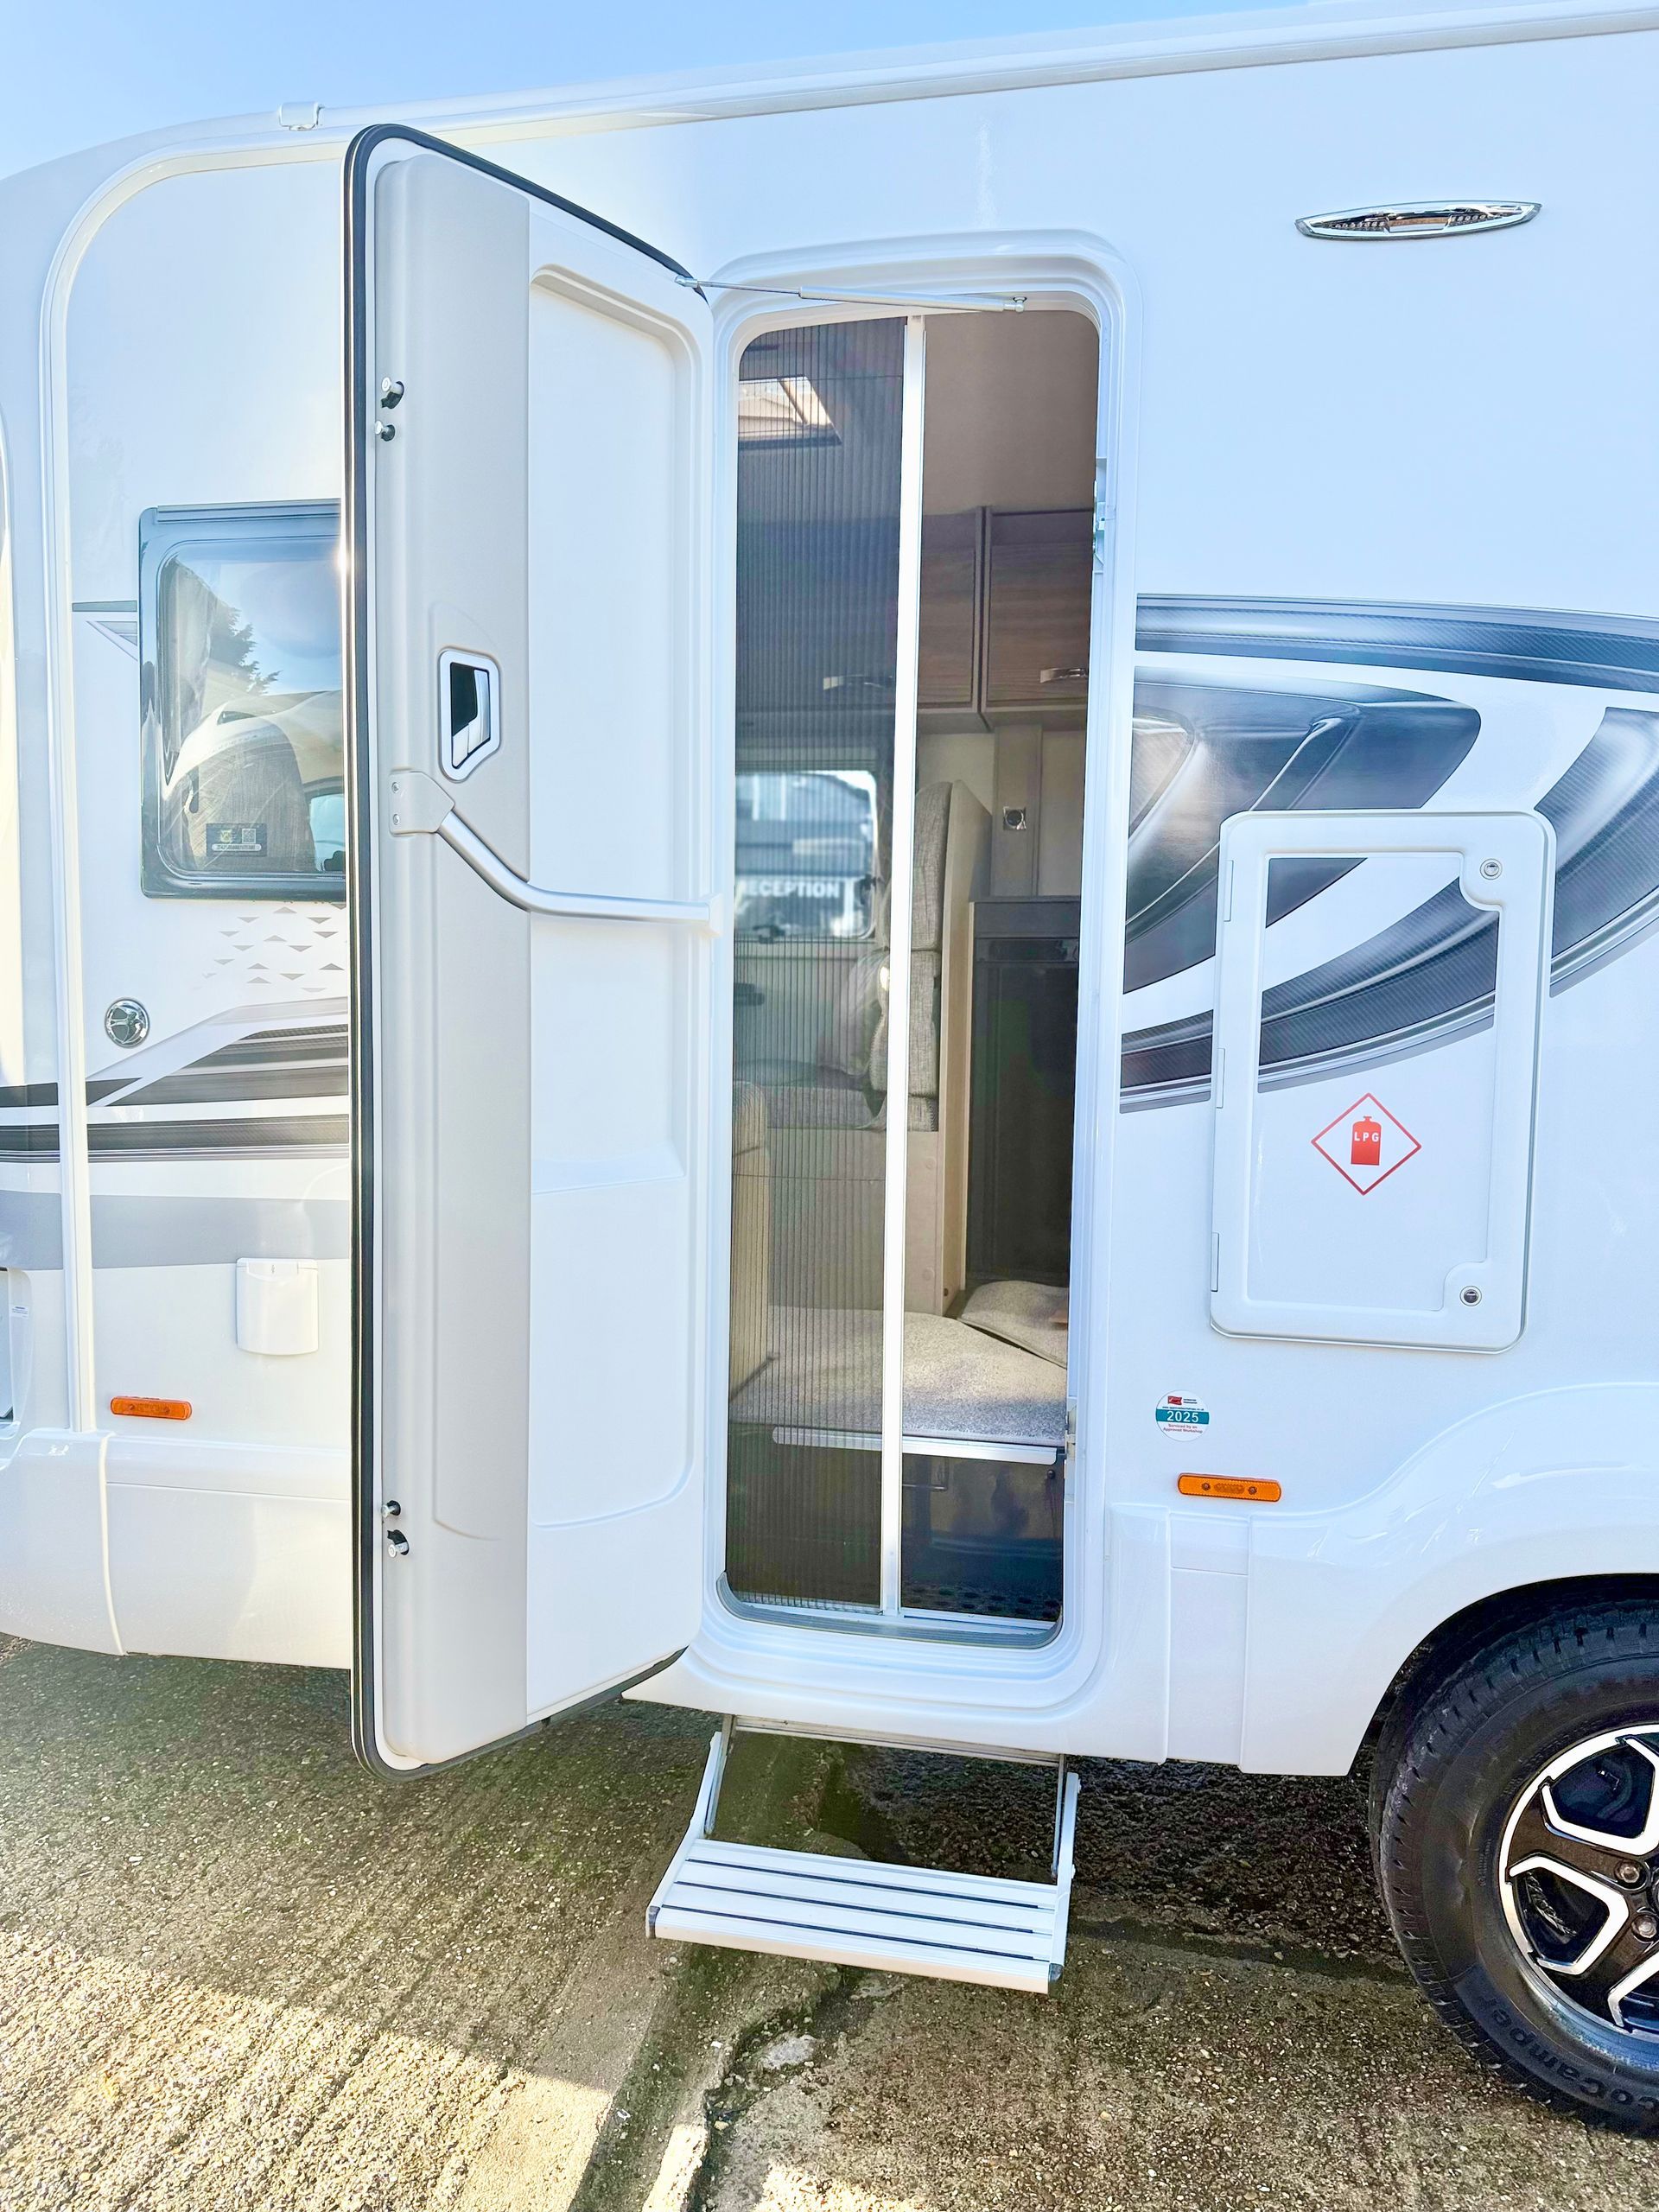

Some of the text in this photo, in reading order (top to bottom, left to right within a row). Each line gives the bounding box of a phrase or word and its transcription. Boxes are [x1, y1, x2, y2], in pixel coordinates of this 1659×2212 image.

[738, 879, 840, 899] ECEPTION
[1354, 1131, 1379, 1142] LPG
[1166, 1410, 1199, 1423] 2025
